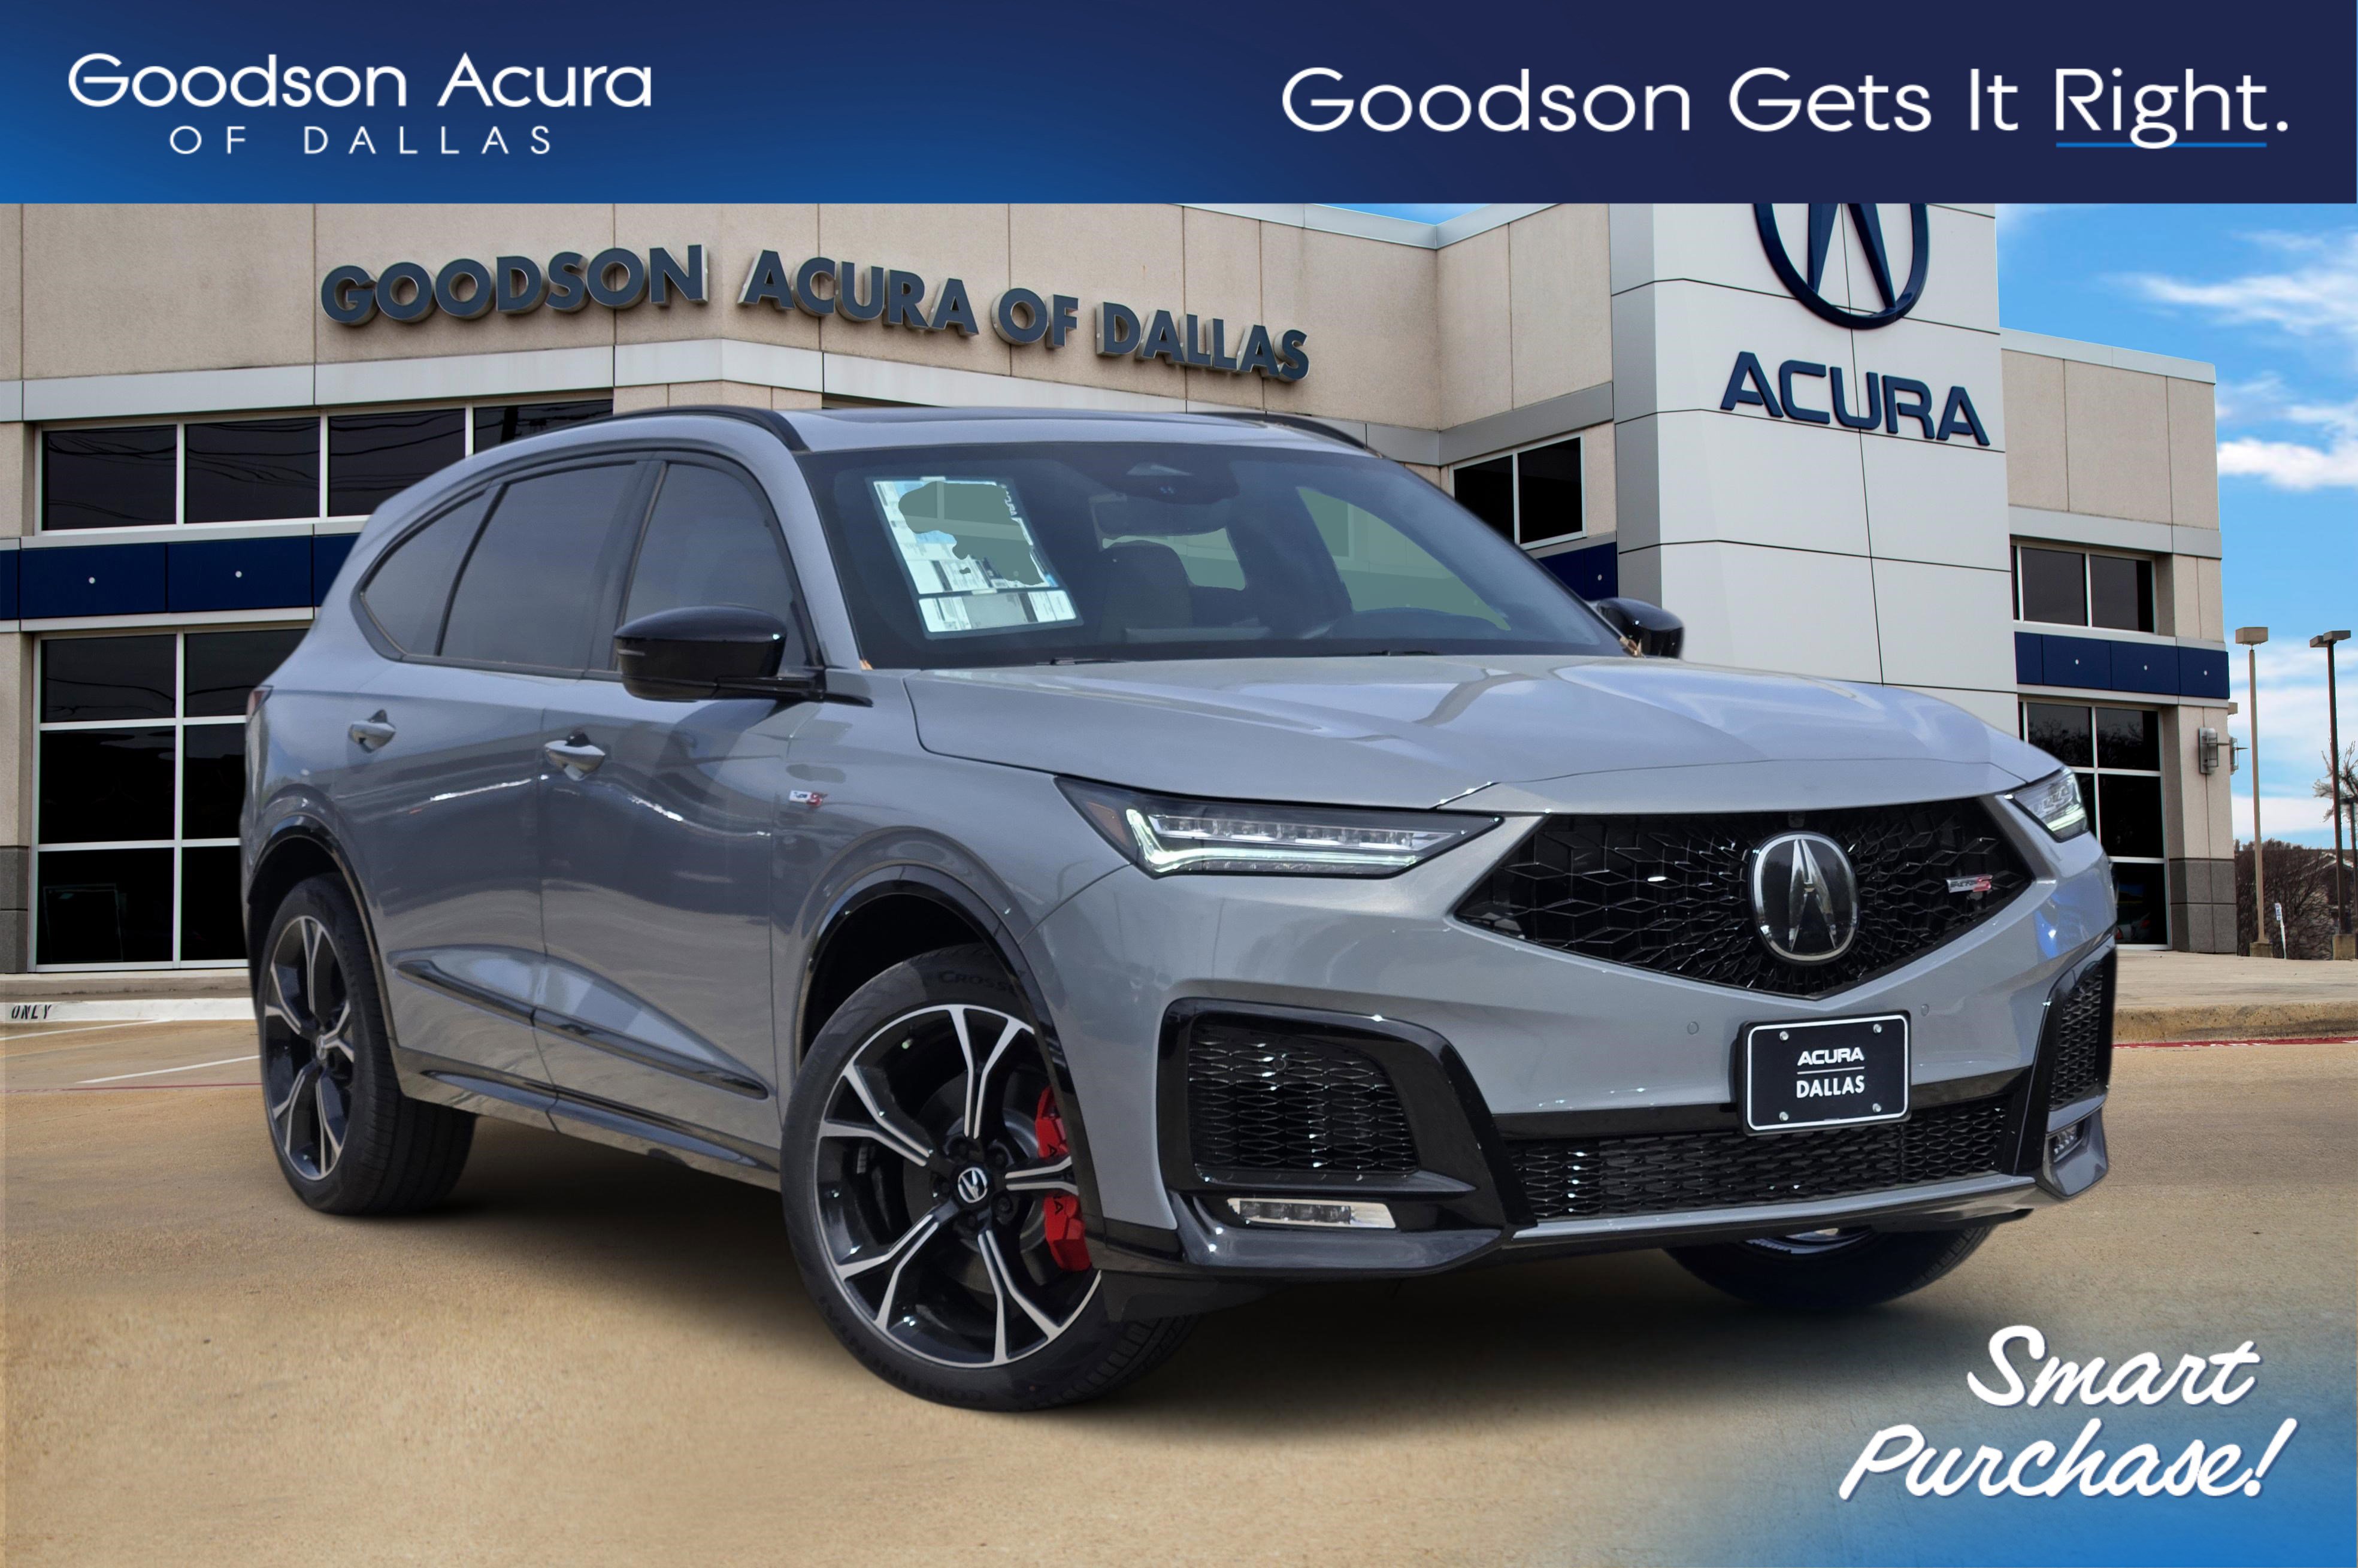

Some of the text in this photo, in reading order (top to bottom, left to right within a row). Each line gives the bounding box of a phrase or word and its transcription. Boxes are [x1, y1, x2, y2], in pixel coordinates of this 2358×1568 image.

[320, 244, 1309, 382] GOODSON ACURA OF DALLAS
[1720, 351, 1990, 446] ACURA
[11, 1004, 52, 1019] ONLY
[1797, 1047, 1865, 1066] ACURA
[1796, 1075, 1865, 1098] DALLAS
